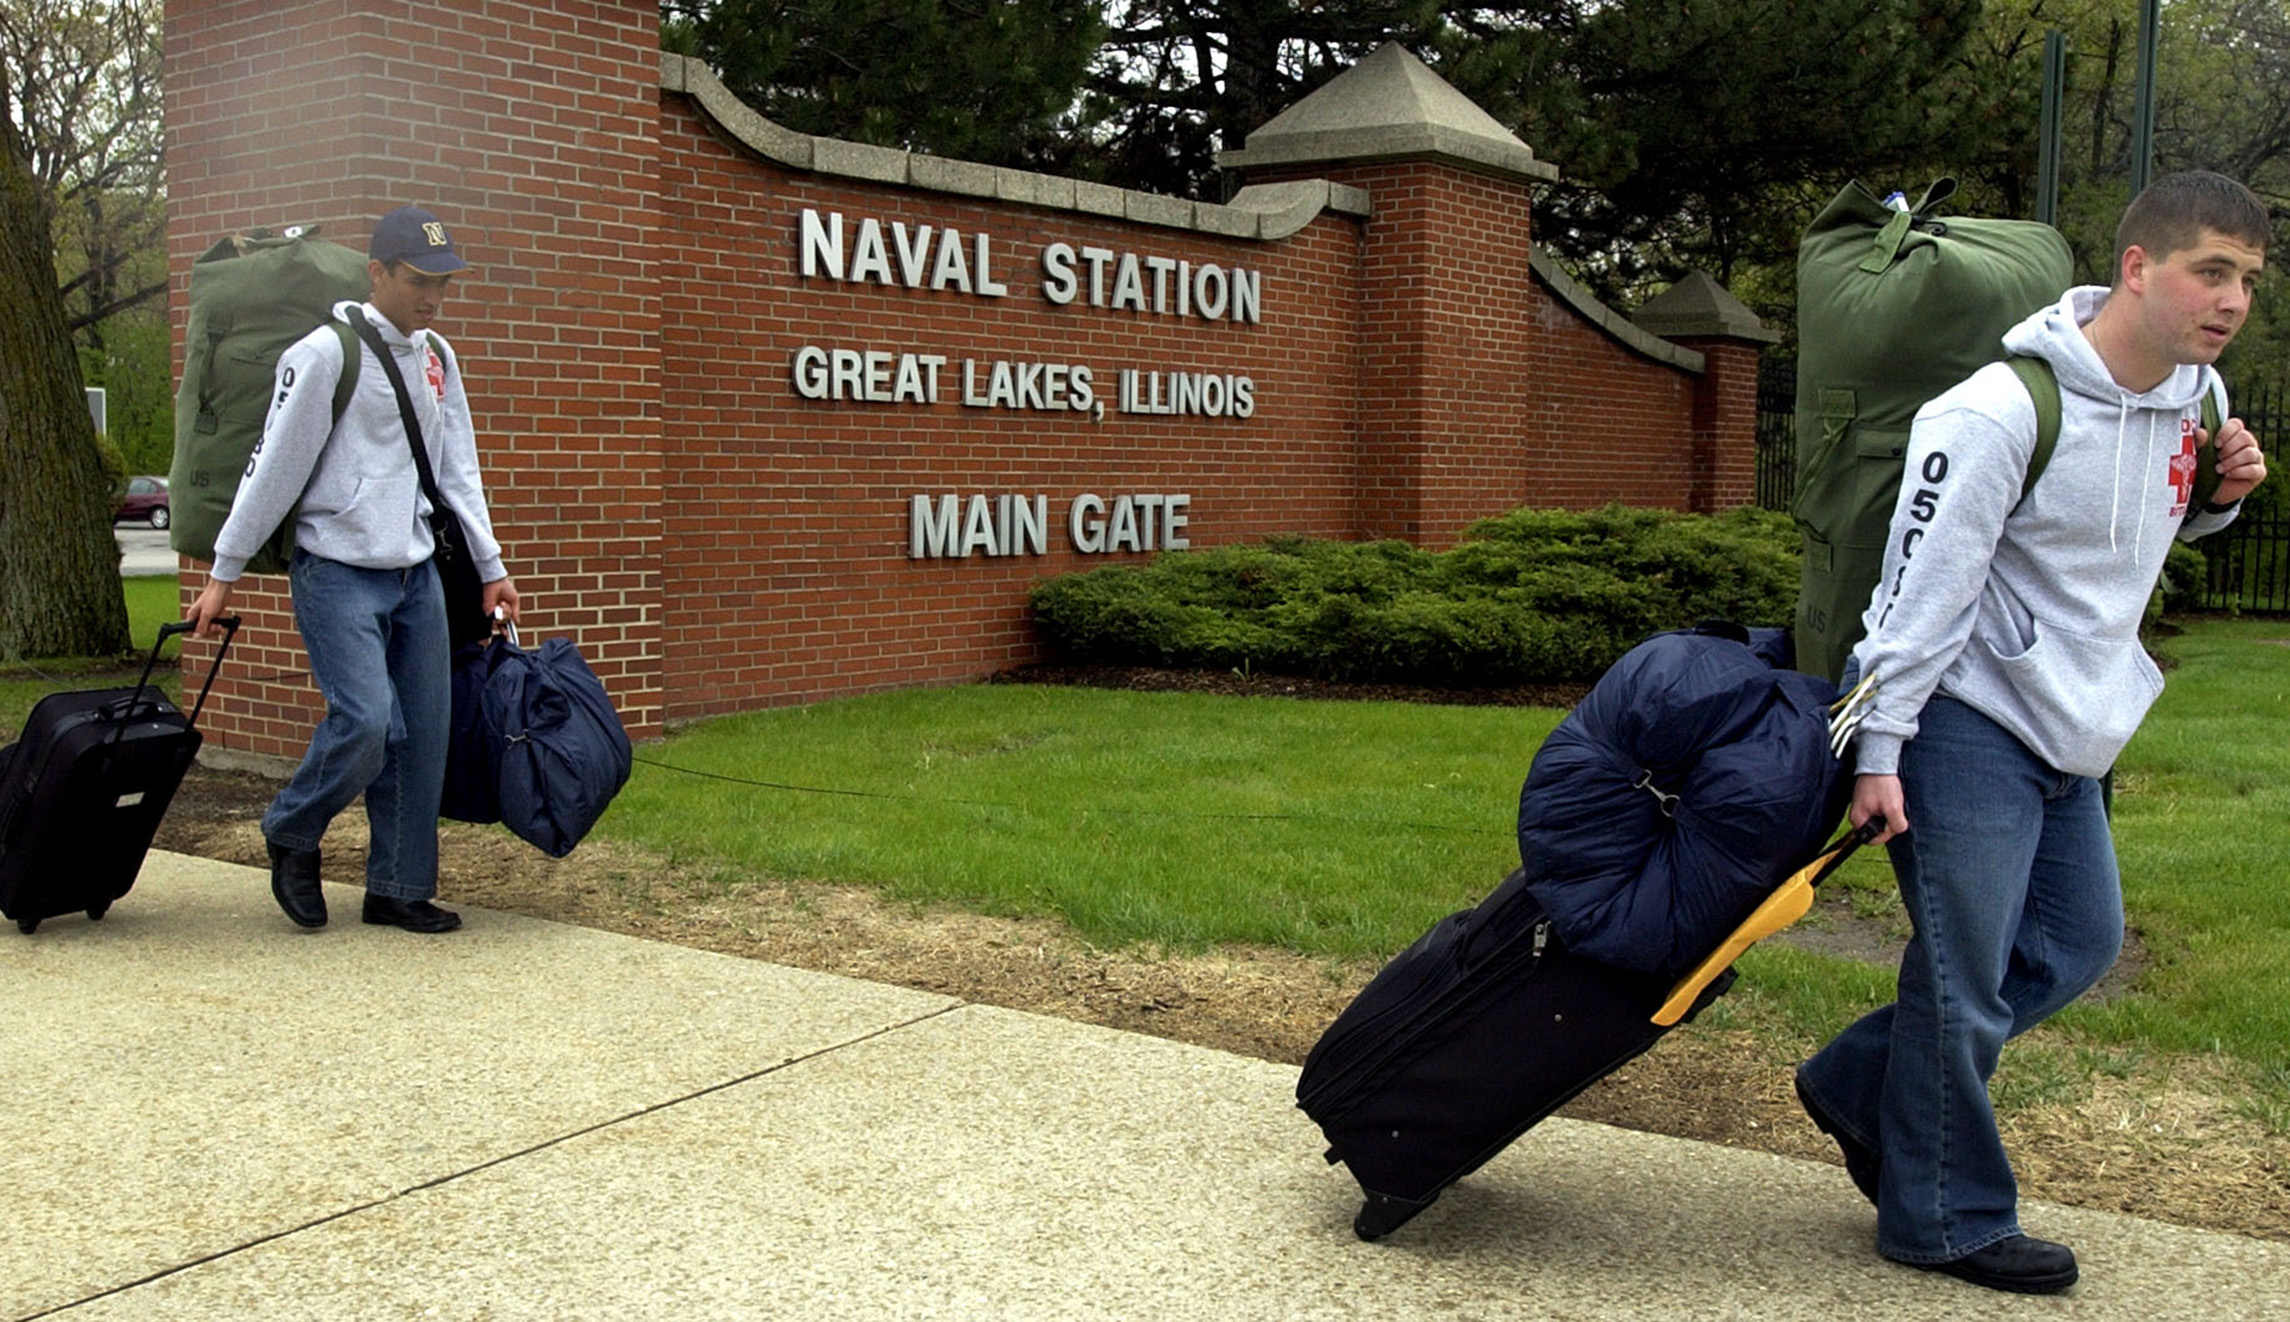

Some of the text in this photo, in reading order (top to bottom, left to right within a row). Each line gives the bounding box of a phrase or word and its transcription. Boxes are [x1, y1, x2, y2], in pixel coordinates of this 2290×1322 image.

[421, 222, 447, 246] N
[801, 208, 1261, 323] NAVAL STATION
[793, 345, 1255, 421] GREAT LAKES, ILLINOIS
[190, 469, 210, 487] US
[910, 493, 1191, 559] MAIN GATE
[1808, 605, 1826, 634] US
